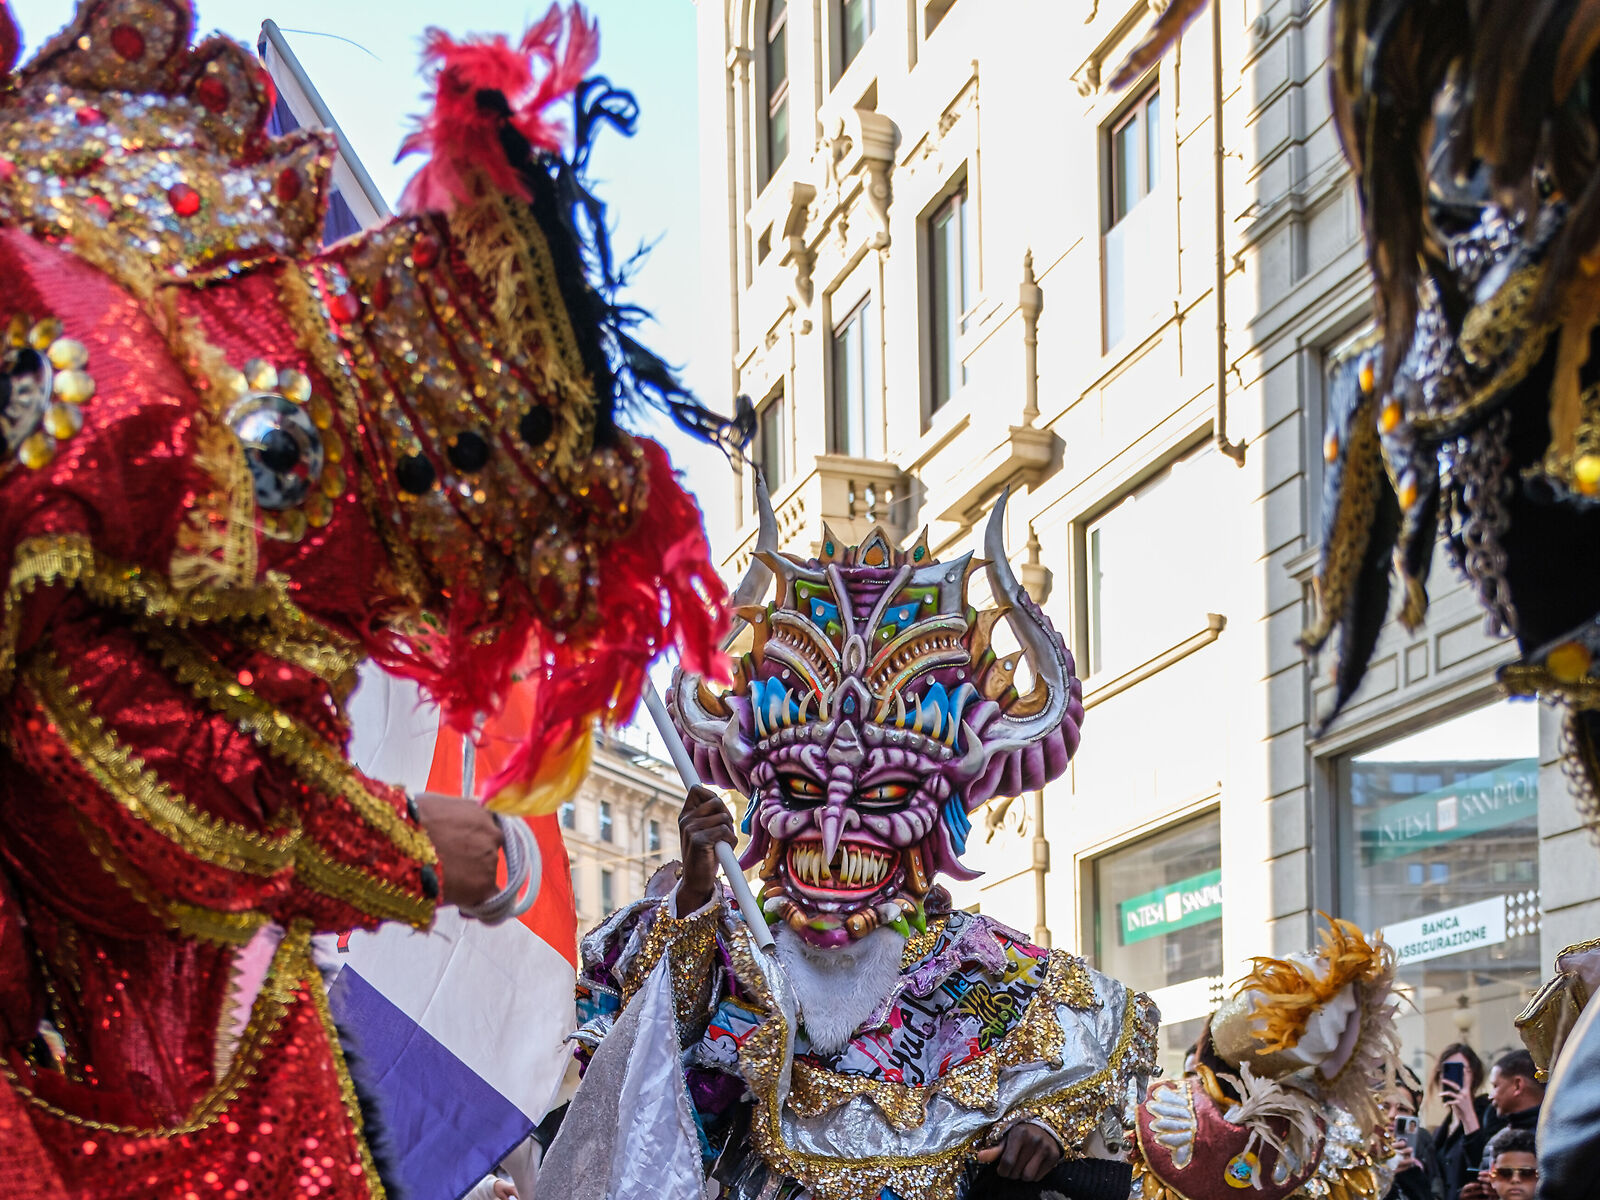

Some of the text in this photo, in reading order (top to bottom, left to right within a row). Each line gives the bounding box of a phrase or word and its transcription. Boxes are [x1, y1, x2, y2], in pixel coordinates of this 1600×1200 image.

[1378, 776, 1538, 847] INTESA SANPAOL
[1127, 903, 1164, 932] INTESA
[1421, 916, 1460, 936] BANCA
[1396, 926, 1487, 959] ASSICURAZIONE
